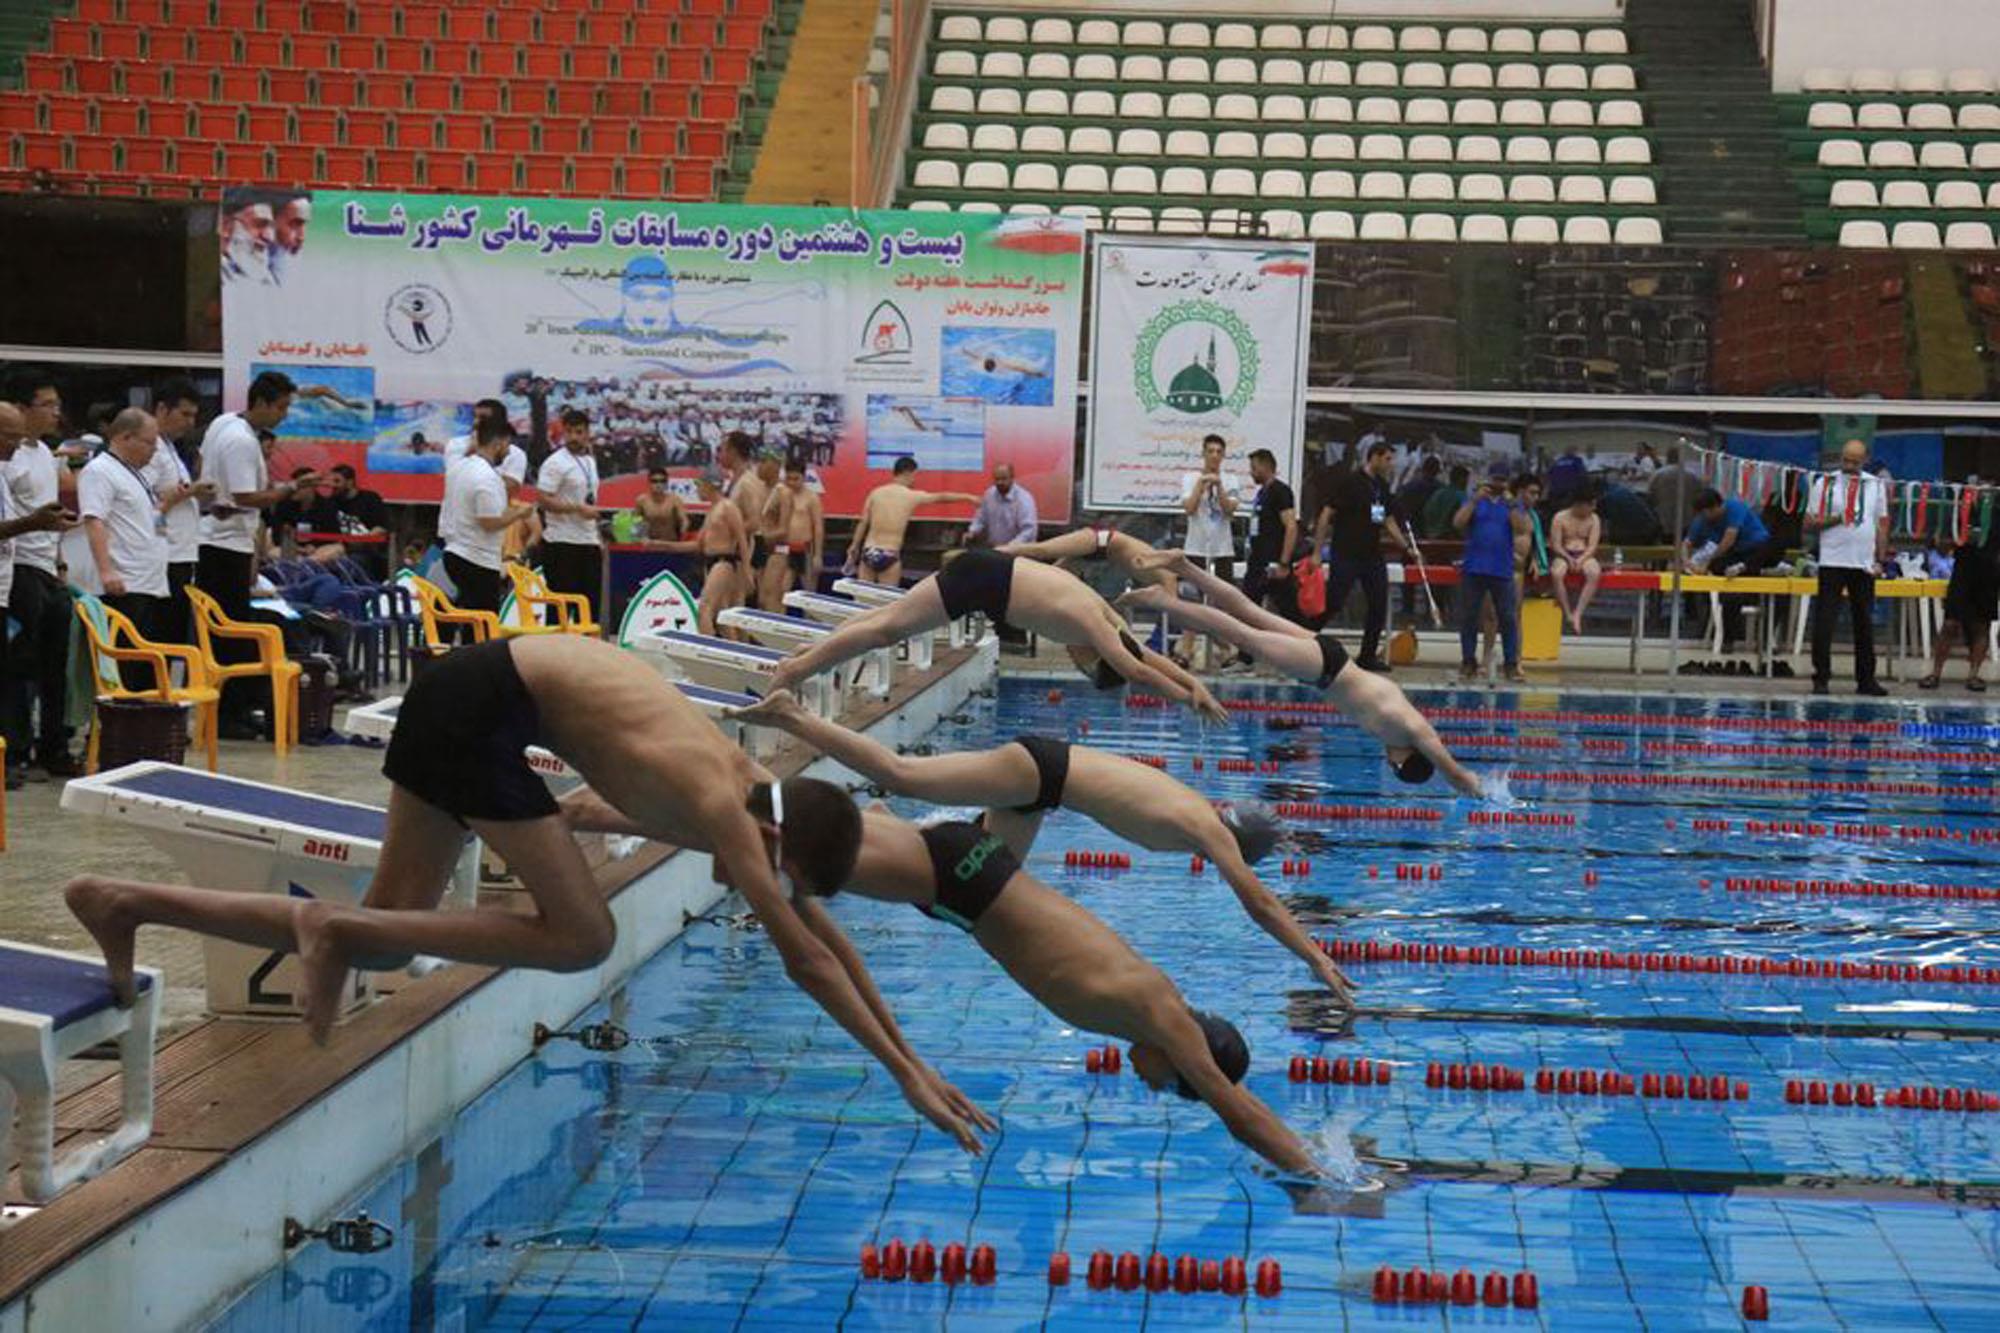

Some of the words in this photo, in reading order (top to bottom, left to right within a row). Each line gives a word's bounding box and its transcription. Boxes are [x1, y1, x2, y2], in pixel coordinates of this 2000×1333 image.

[346, 204, 405, 236] شنا
[411, 208, 476, 248] کشور
[482, 209, 601, 252] قهرمانی
[612, 213, 710, 254] مسابقات
[715, 226, 773, 260] دوره
[780, 221, 869, 261] هشتمین
[879, 236, 892, 264] و
[900, 230, 963, 266] بیست
[530, 755, 564, 773] anti
[303, 839, 350, 861] anti
